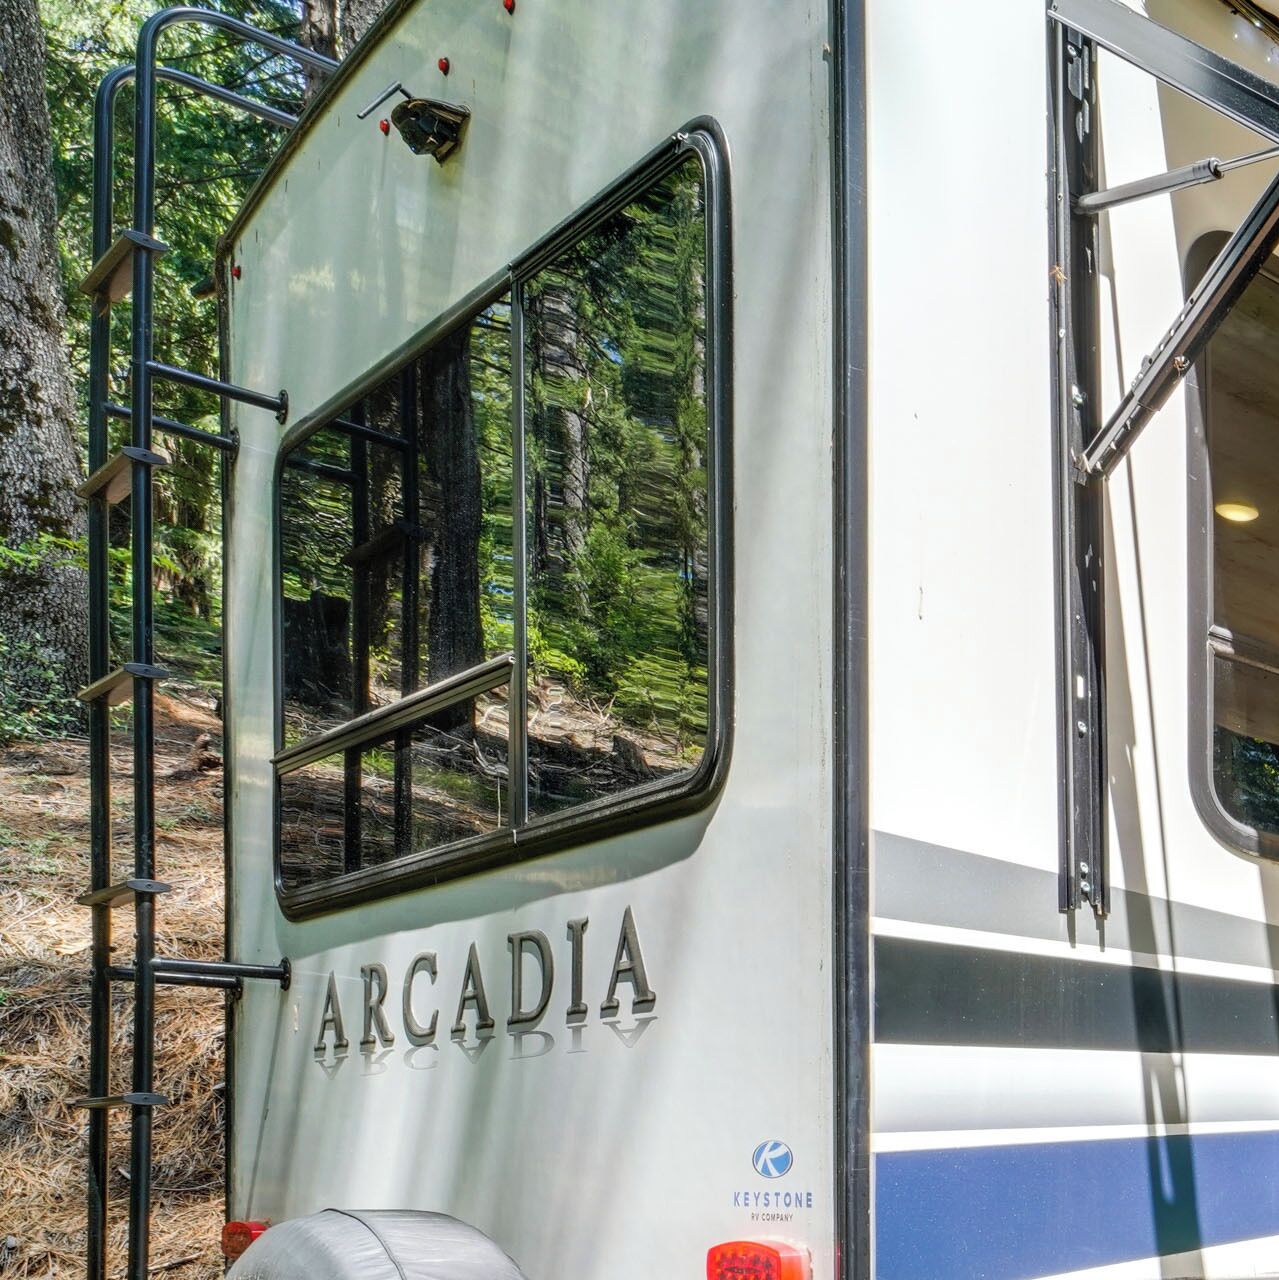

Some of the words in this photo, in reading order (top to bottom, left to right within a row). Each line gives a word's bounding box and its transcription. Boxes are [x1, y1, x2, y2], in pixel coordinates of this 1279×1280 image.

[313, 905, 657, 1057] ARCADIA
[733, 1191, 813, 1208] KEYSTONE
[751, 1213, 760, 1221] RV
[762, 1213, 793, 1222] COMPANY
